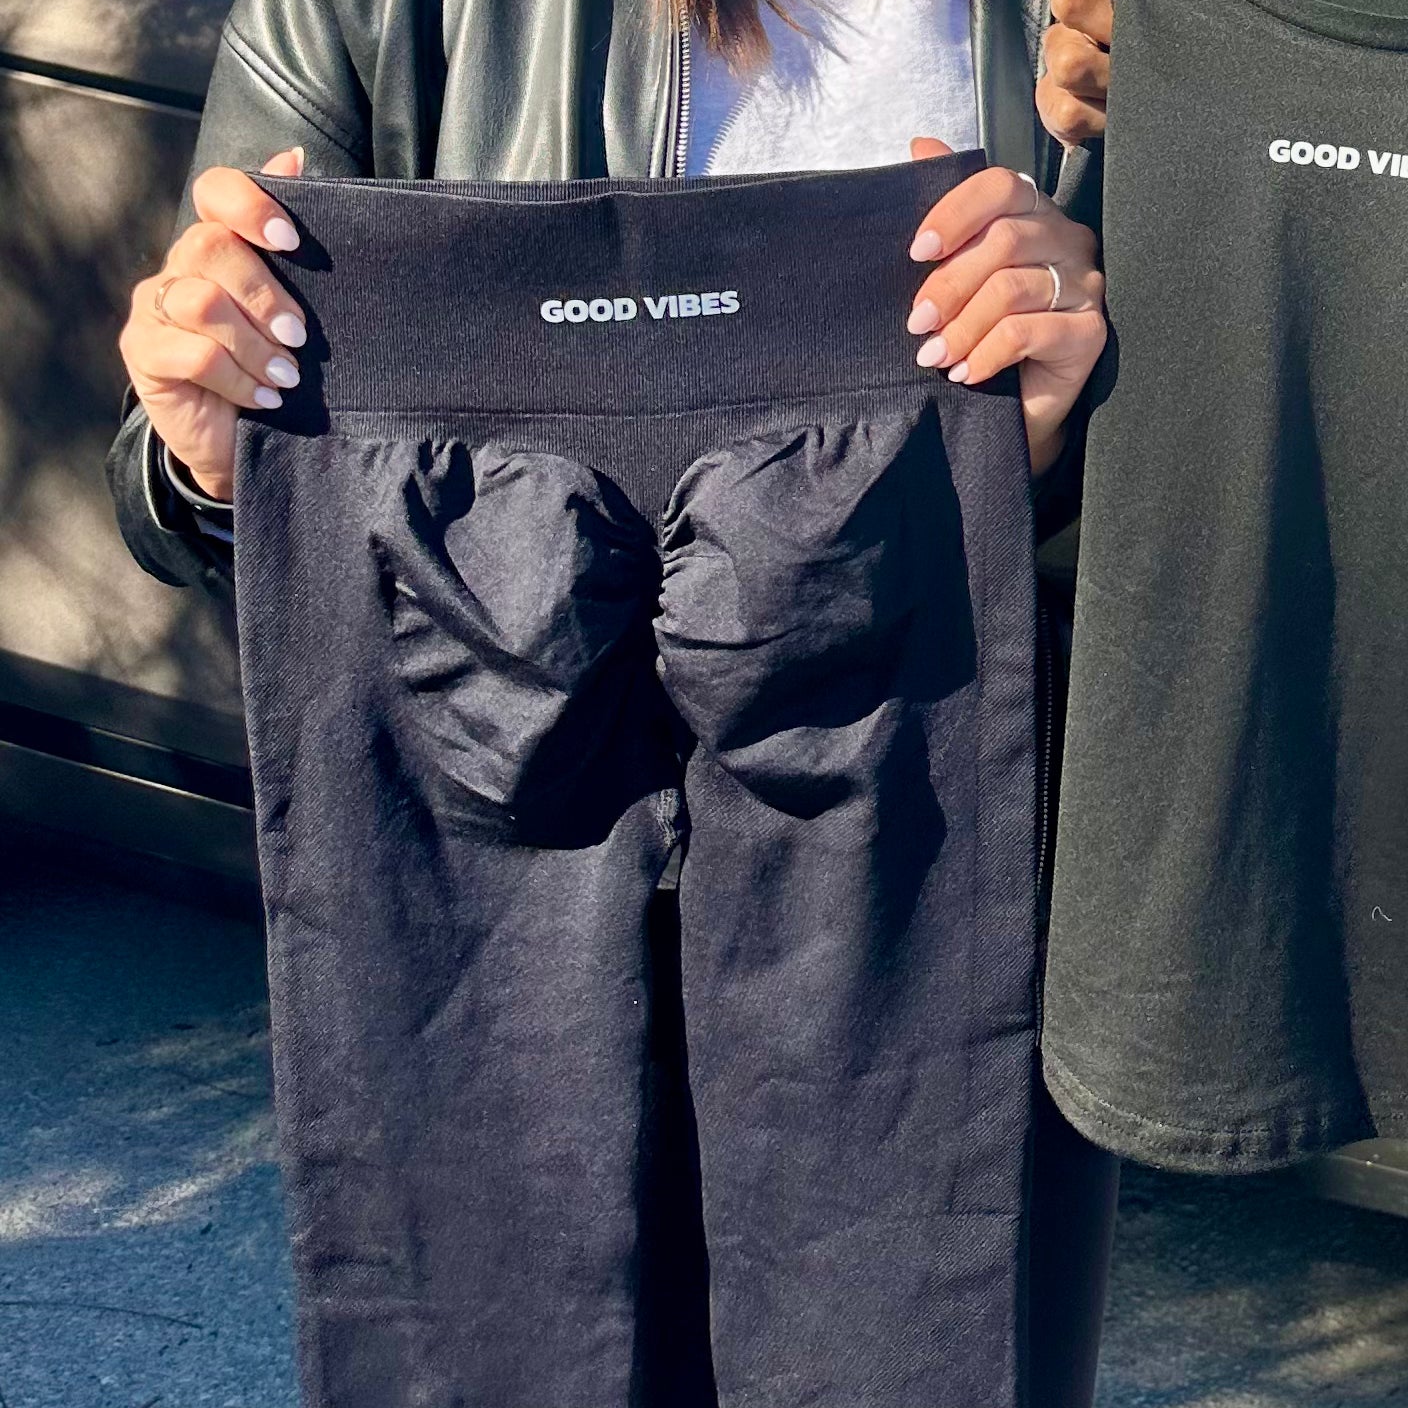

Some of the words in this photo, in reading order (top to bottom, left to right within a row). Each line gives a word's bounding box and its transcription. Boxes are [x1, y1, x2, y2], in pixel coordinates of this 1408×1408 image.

[1268, 139, 1361, 170] GOOD
[540, 297, 638, 324] GOOD
[643, 290, 740, 320] VIBES
